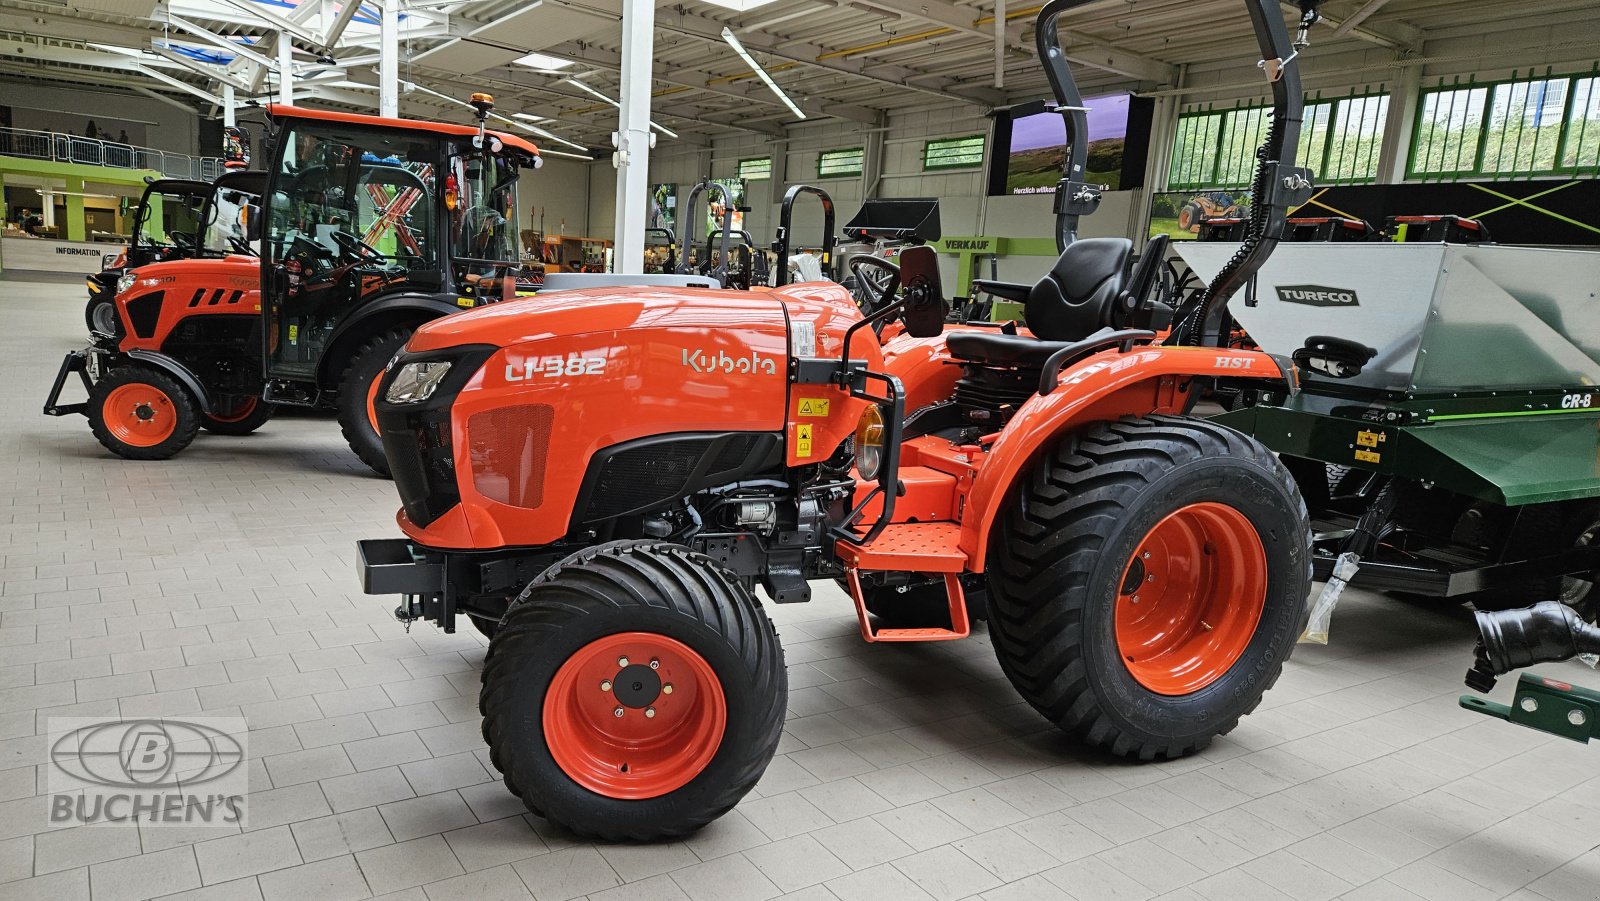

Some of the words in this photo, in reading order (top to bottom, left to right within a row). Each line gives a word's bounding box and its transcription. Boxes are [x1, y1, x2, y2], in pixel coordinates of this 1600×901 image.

[1013, 186, 1035, 194] Herzlich
[945, 240, 989, 250] VERKAUF
[55, 247, 101, 257] INFORMATION
[1280, 289, 1353, 303] TURFCO
[682, 348, 776, 375] Kubota
[1214, 356, 1255, 369] HST
[505, 357, 607, 382] L1-382
[1561, 393, 1592, 409] CR-8
